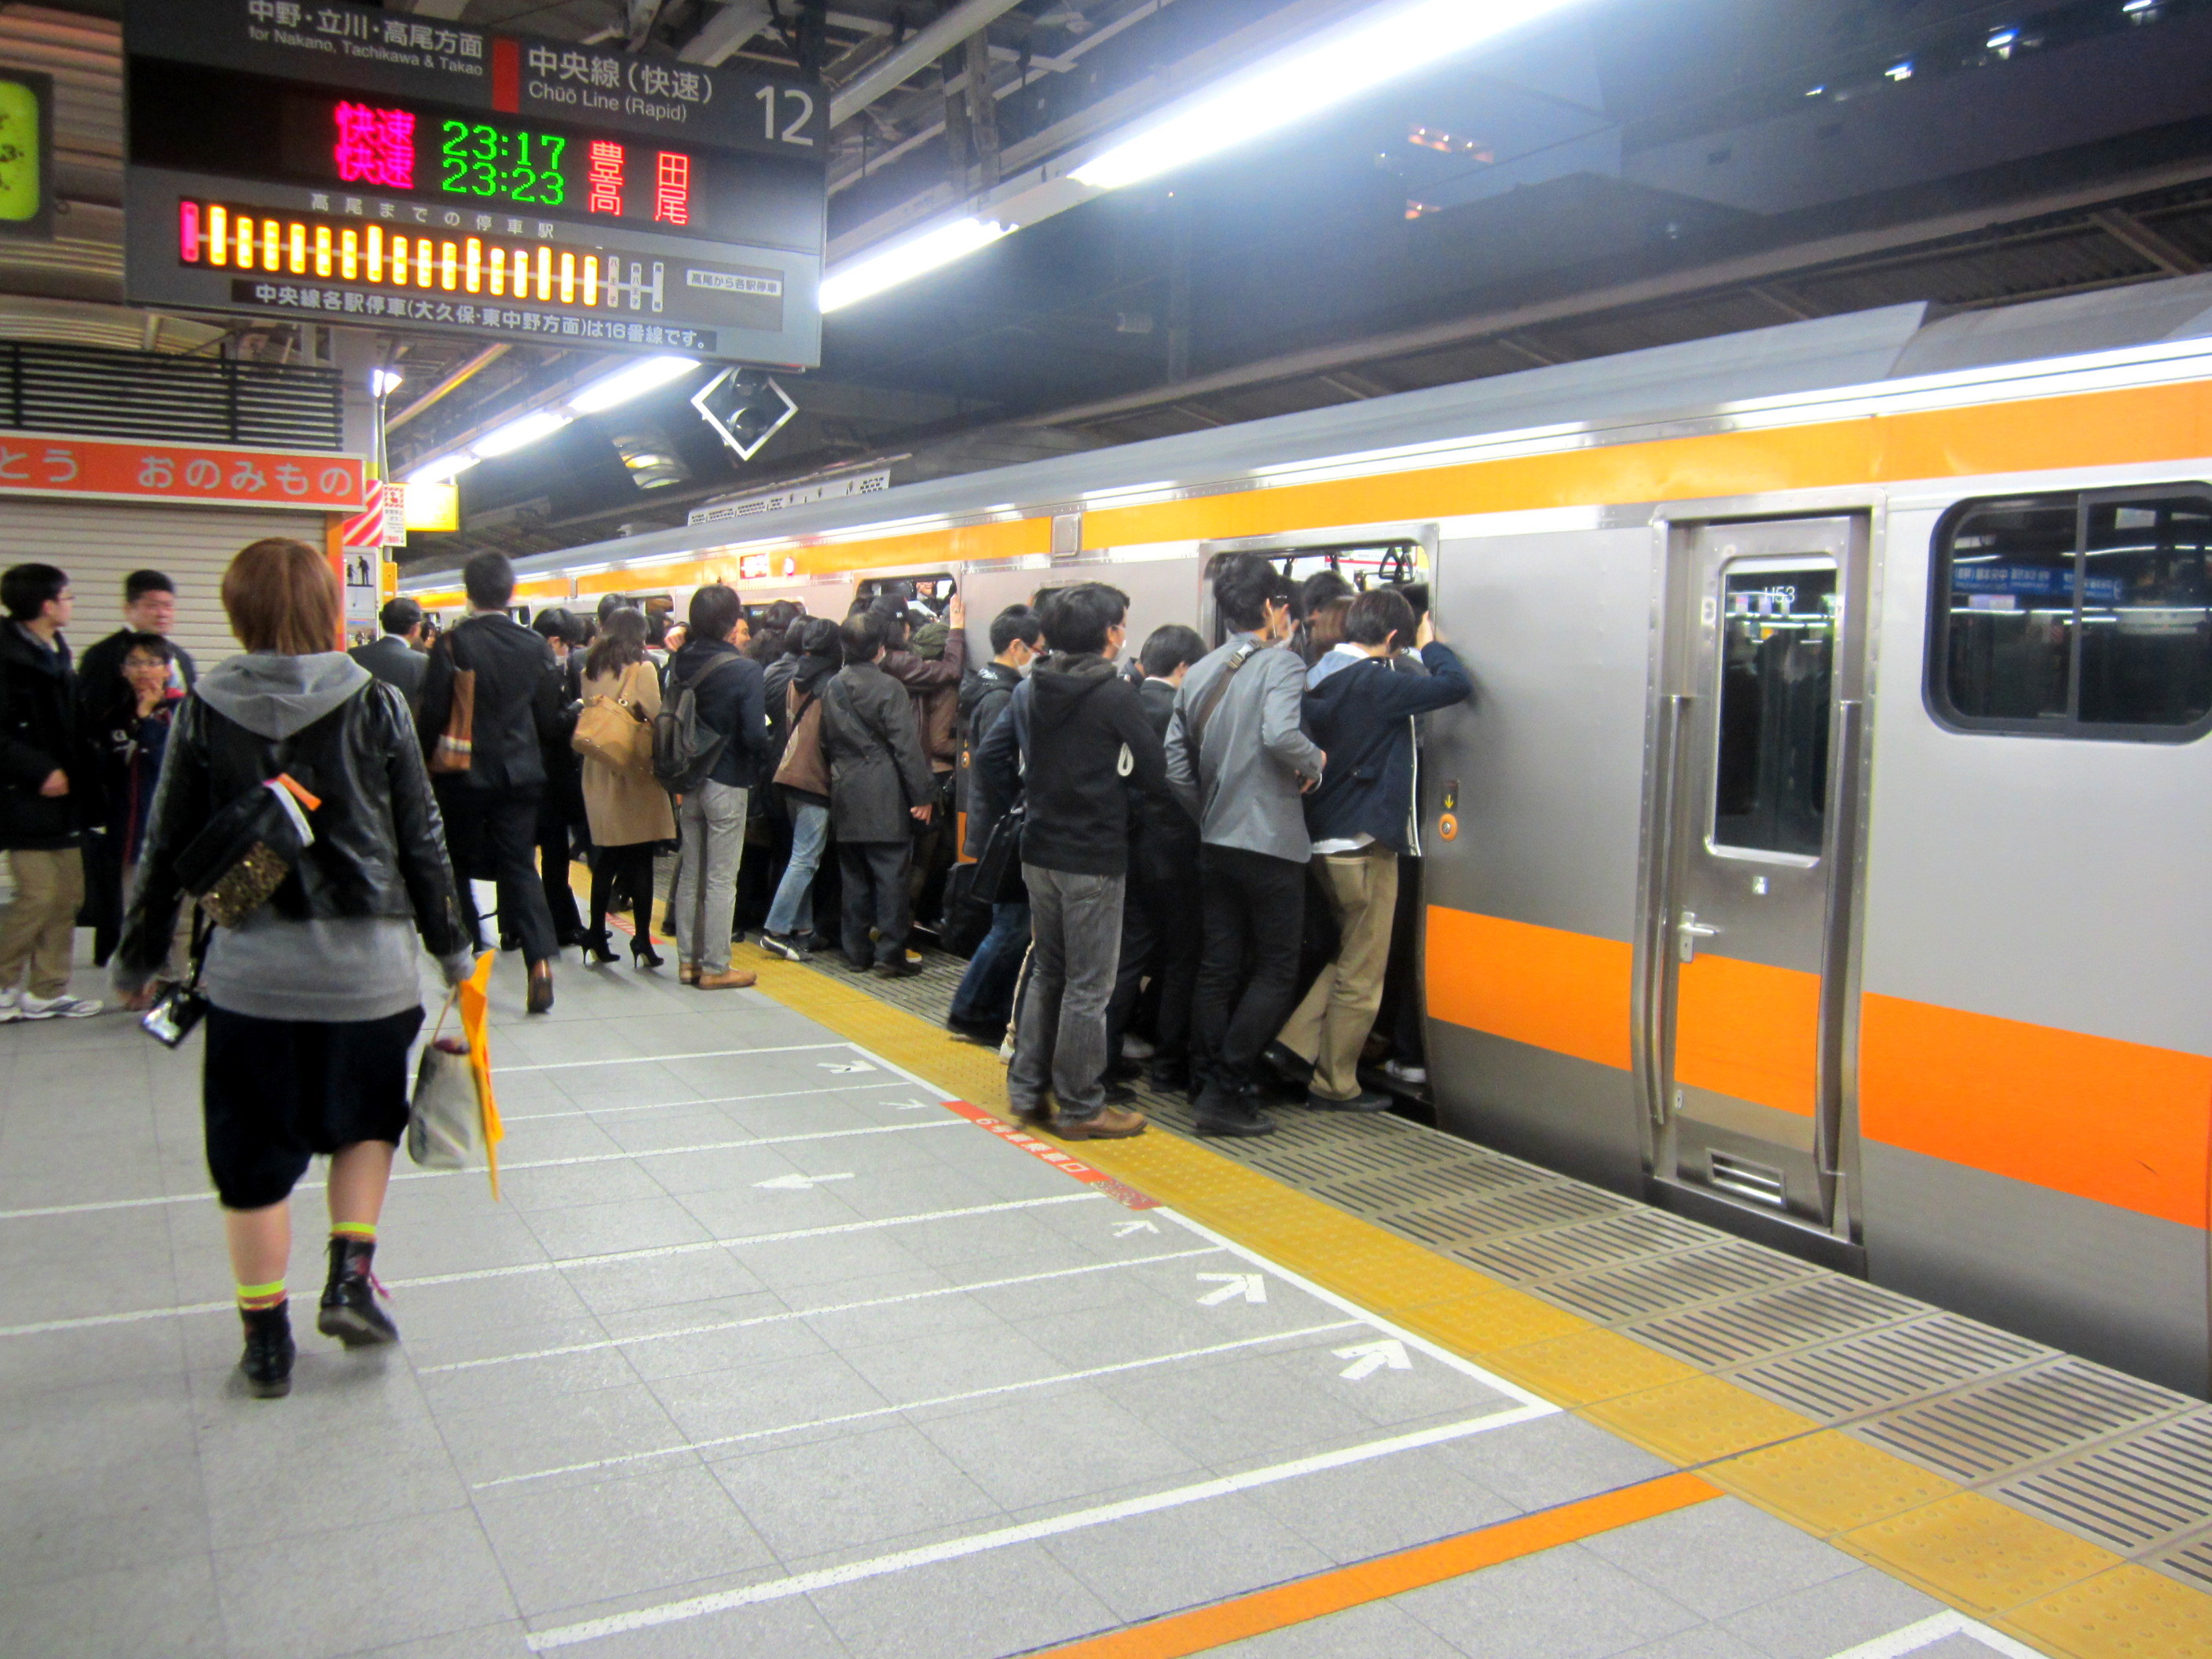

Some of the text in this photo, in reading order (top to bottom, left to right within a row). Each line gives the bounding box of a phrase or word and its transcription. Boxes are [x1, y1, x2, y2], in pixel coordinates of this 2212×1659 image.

[249, 25, 483, 77] for Nakano, Tachikawa & Takao
[583, 90, 619, 112] Line
[625, 95, 687, 123] (Rapid)
[755, 86, 814, 146] 12
[335, 101, 416, 152] 快速
[442, 120, 566, 170] 23:17
[441, 157, 565, 205] 23:23
[589, 183, 689, 225] 高尾
[0, 446, 353, 496] とう おのみもの
